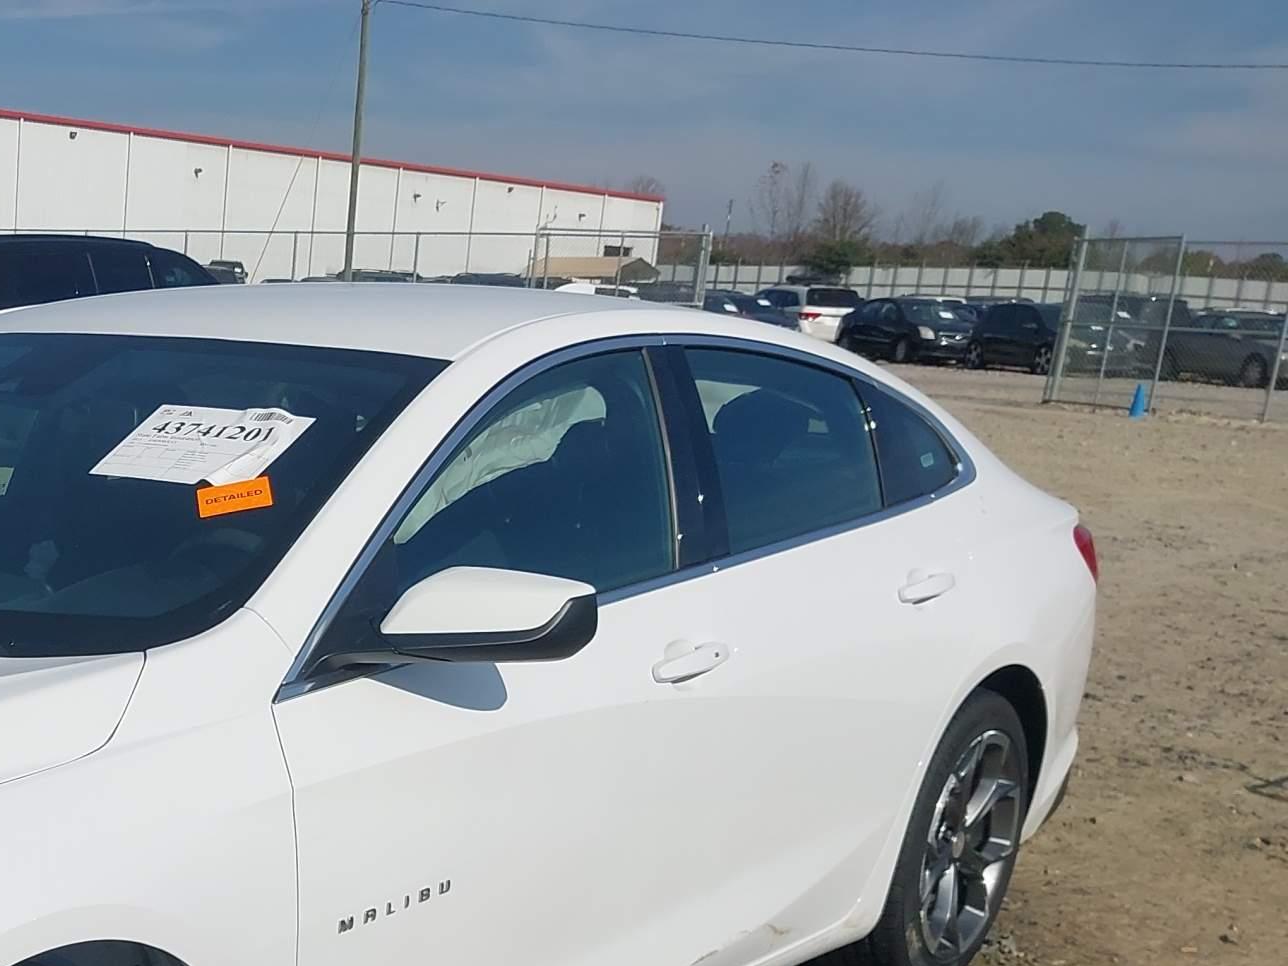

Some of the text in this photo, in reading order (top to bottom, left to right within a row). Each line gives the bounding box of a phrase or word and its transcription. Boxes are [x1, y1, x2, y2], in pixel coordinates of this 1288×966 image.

[152, 420, 275, 442] 43741201
[205, 489, 263, 505] DETAILED
[338, 879, 451, 934] MALIBU
